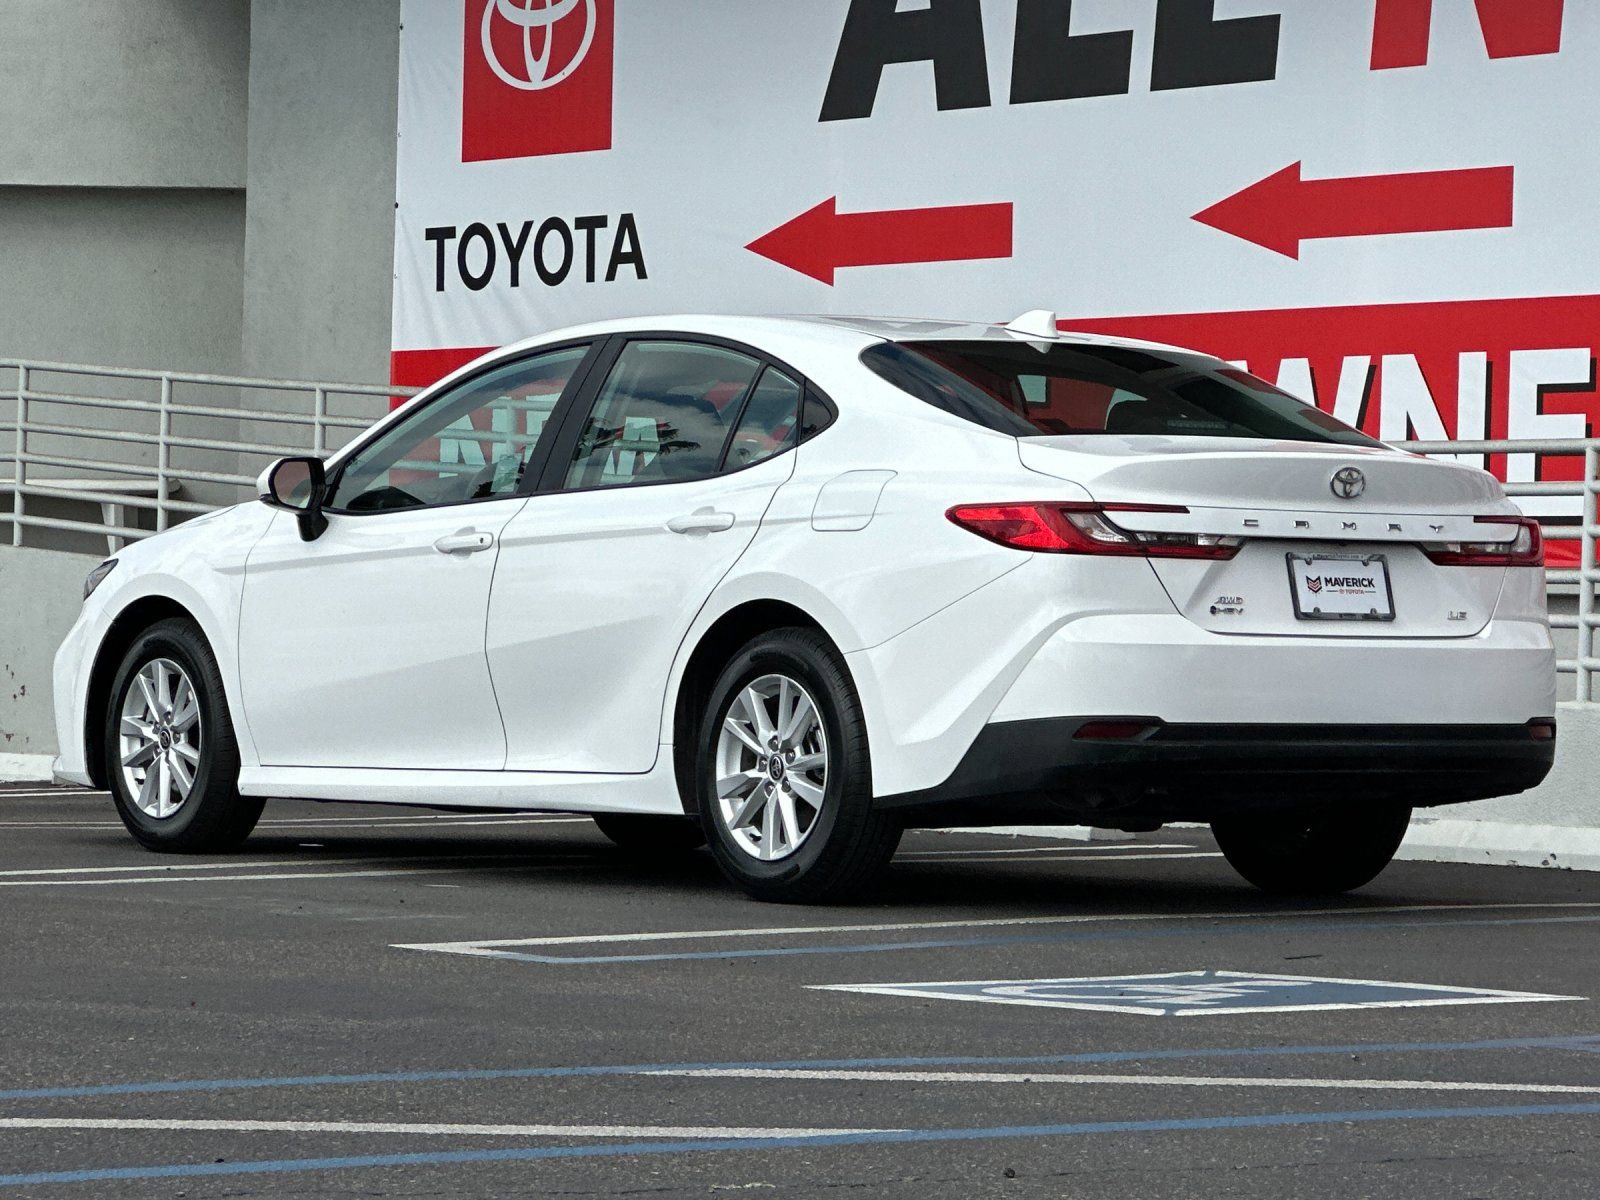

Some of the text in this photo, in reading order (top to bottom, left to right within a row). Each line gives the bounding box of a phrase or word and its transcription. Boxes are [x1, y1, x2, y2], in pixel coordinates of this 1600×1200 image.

[424, 212, 648, 292] TOYOTA
[1243, 518, 1443, 532] CAMRY
[1324, 576, 1376, 588] MAVERICK
[1447, 610, 1467, 621] LE
